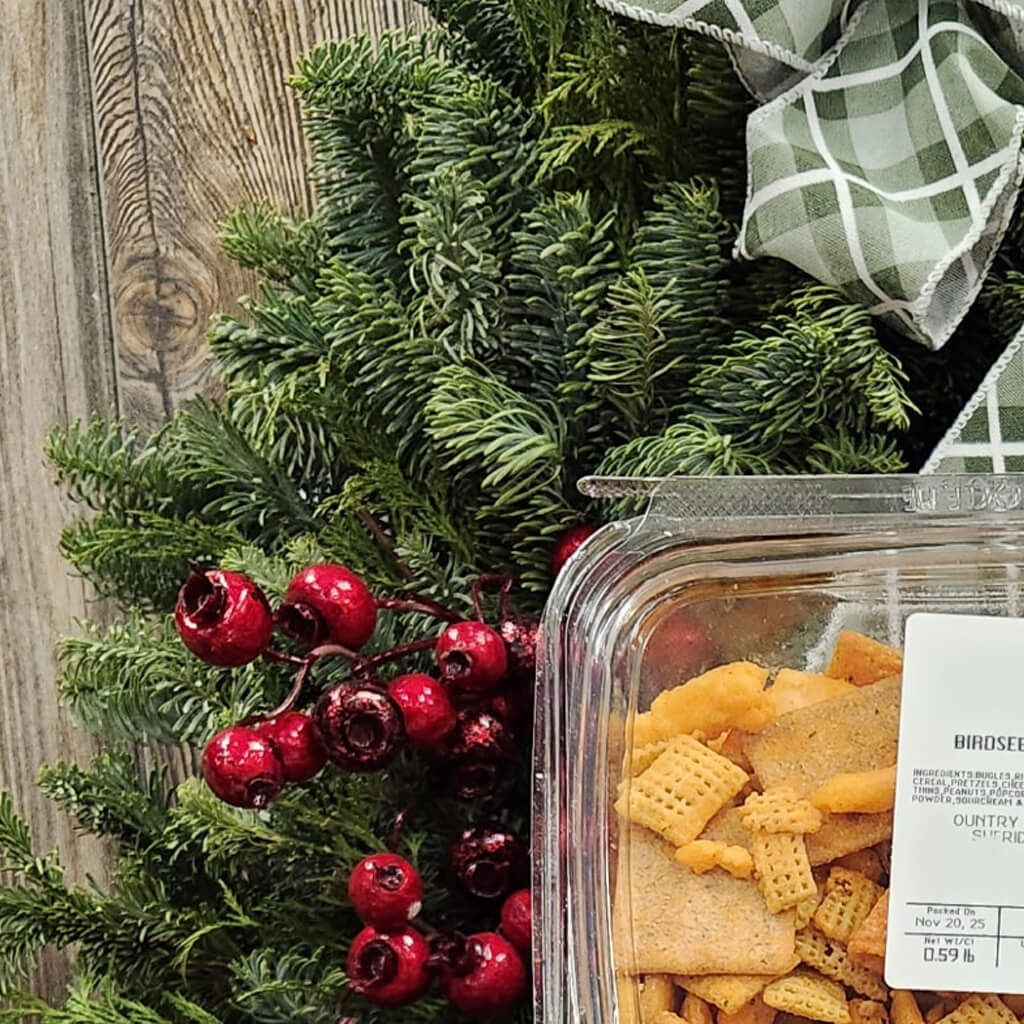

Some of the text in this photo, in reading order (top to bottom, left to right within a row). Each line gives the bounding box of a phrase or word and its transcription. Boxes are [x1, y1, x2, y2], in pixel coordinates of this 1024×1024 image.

[927, 906, 976, 916] Packed On
[915, 917, 986, 930] Nov 20, 25
[923, 947, 975, 964] 0.59 lb
